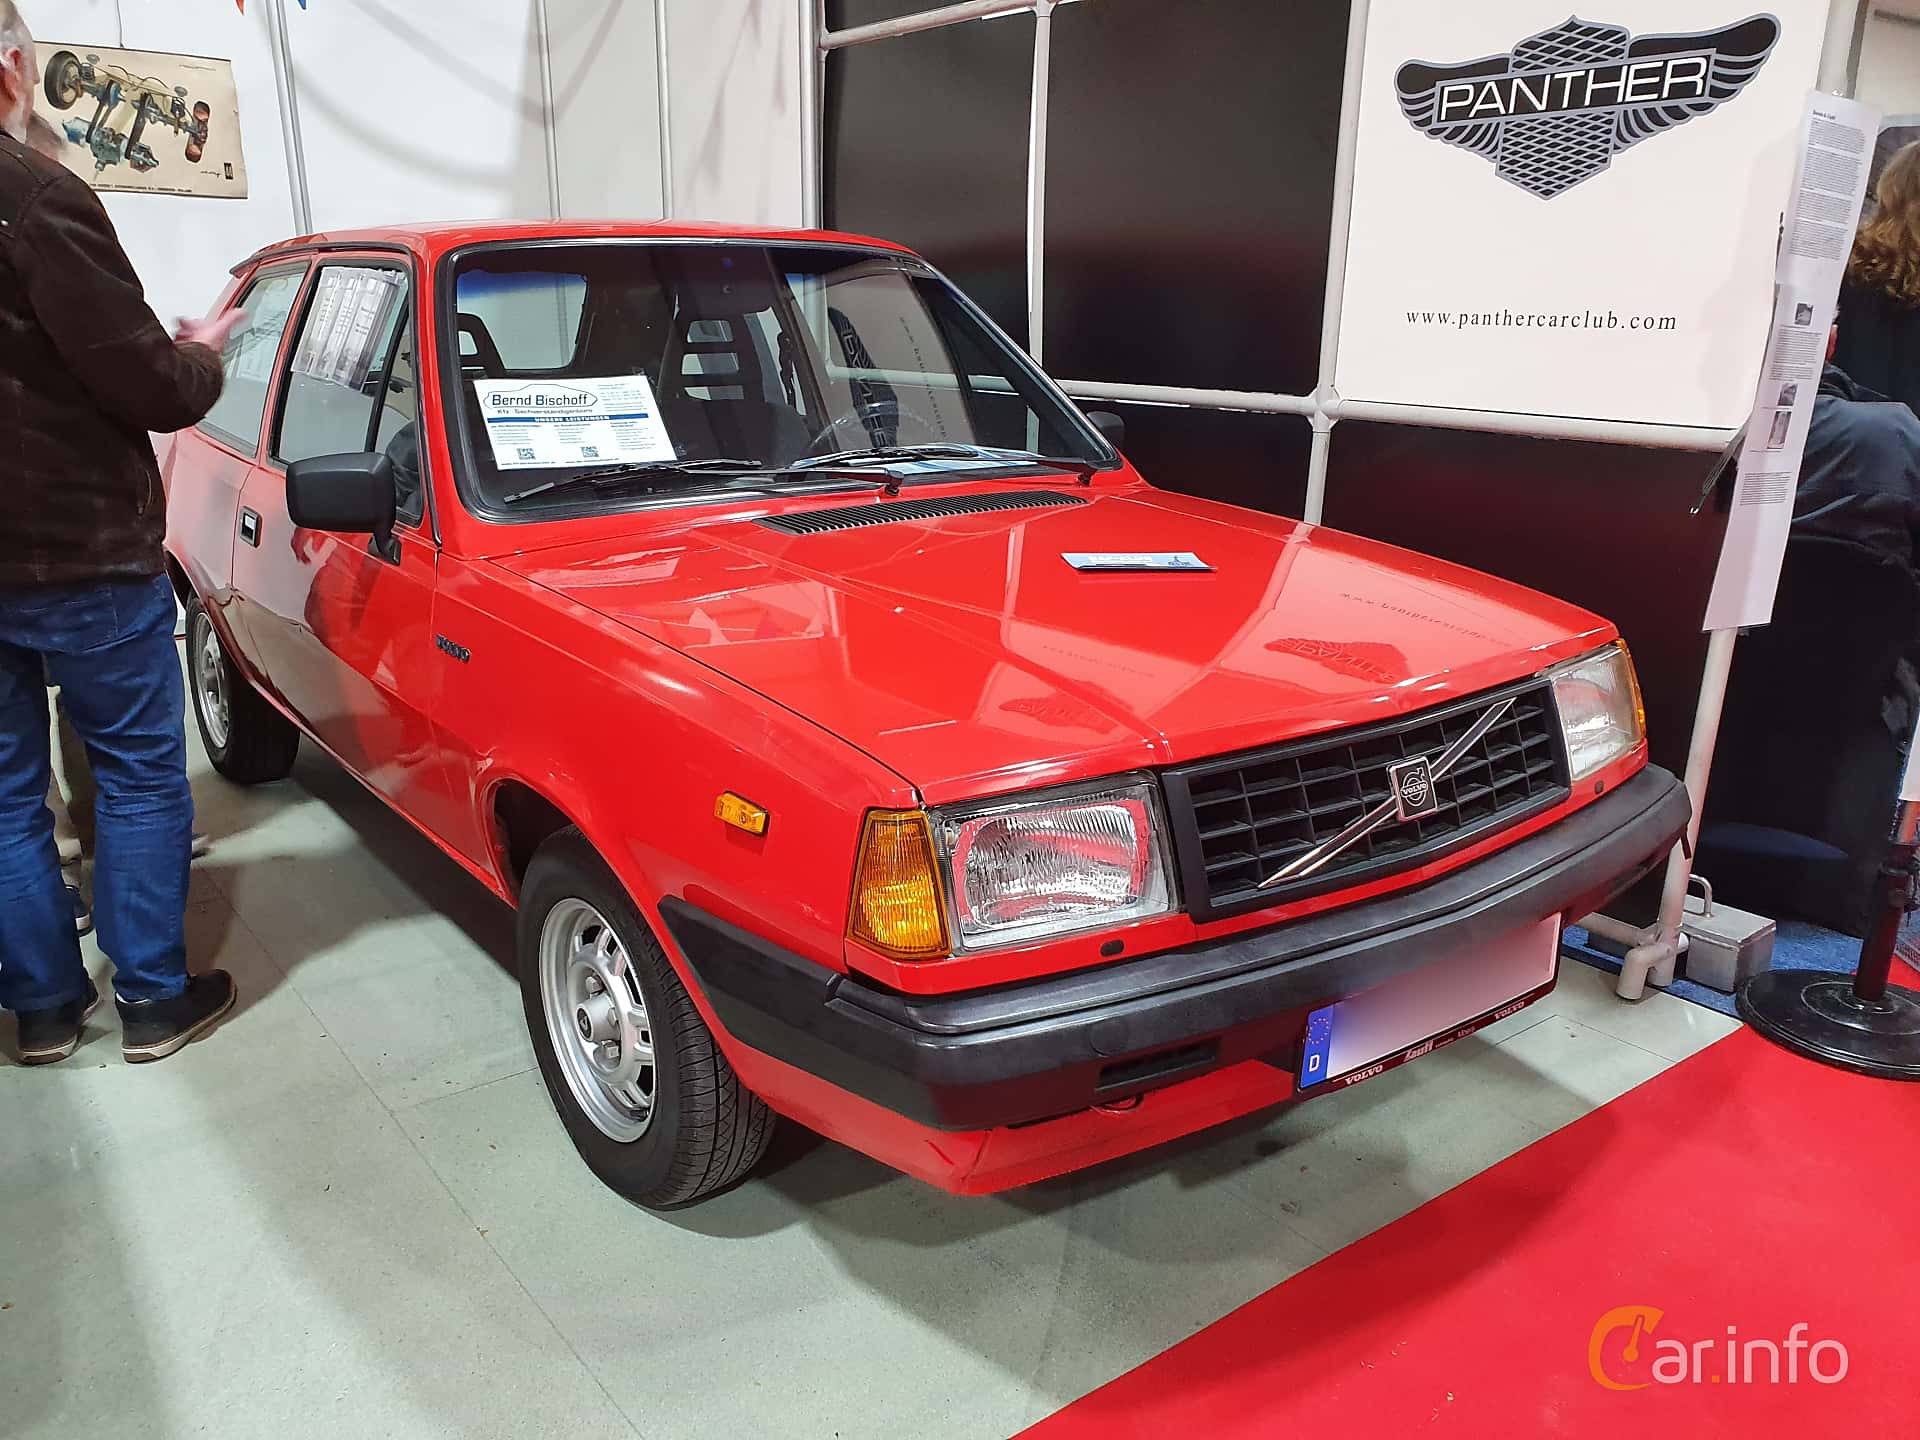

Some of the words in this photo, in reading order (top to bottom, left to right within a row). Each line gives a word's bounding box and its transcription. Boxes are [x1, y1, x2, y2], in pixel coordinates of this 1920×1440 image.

[1440, 56, 1708, 121] PANTHER
[1406, 309, 1677, 330] www.panthercarclub.com
[492, 394, 532, 406] Bernd
[535, 393, 588, 406] Bischoff
[1402, 783, 1427, 795] VOLVO
[1344, 1065, 1383, 1085] VOLVO
[1494, 1001, 1525, 1020] VOLVO
[1308, 1054, 1320, 1073] D
